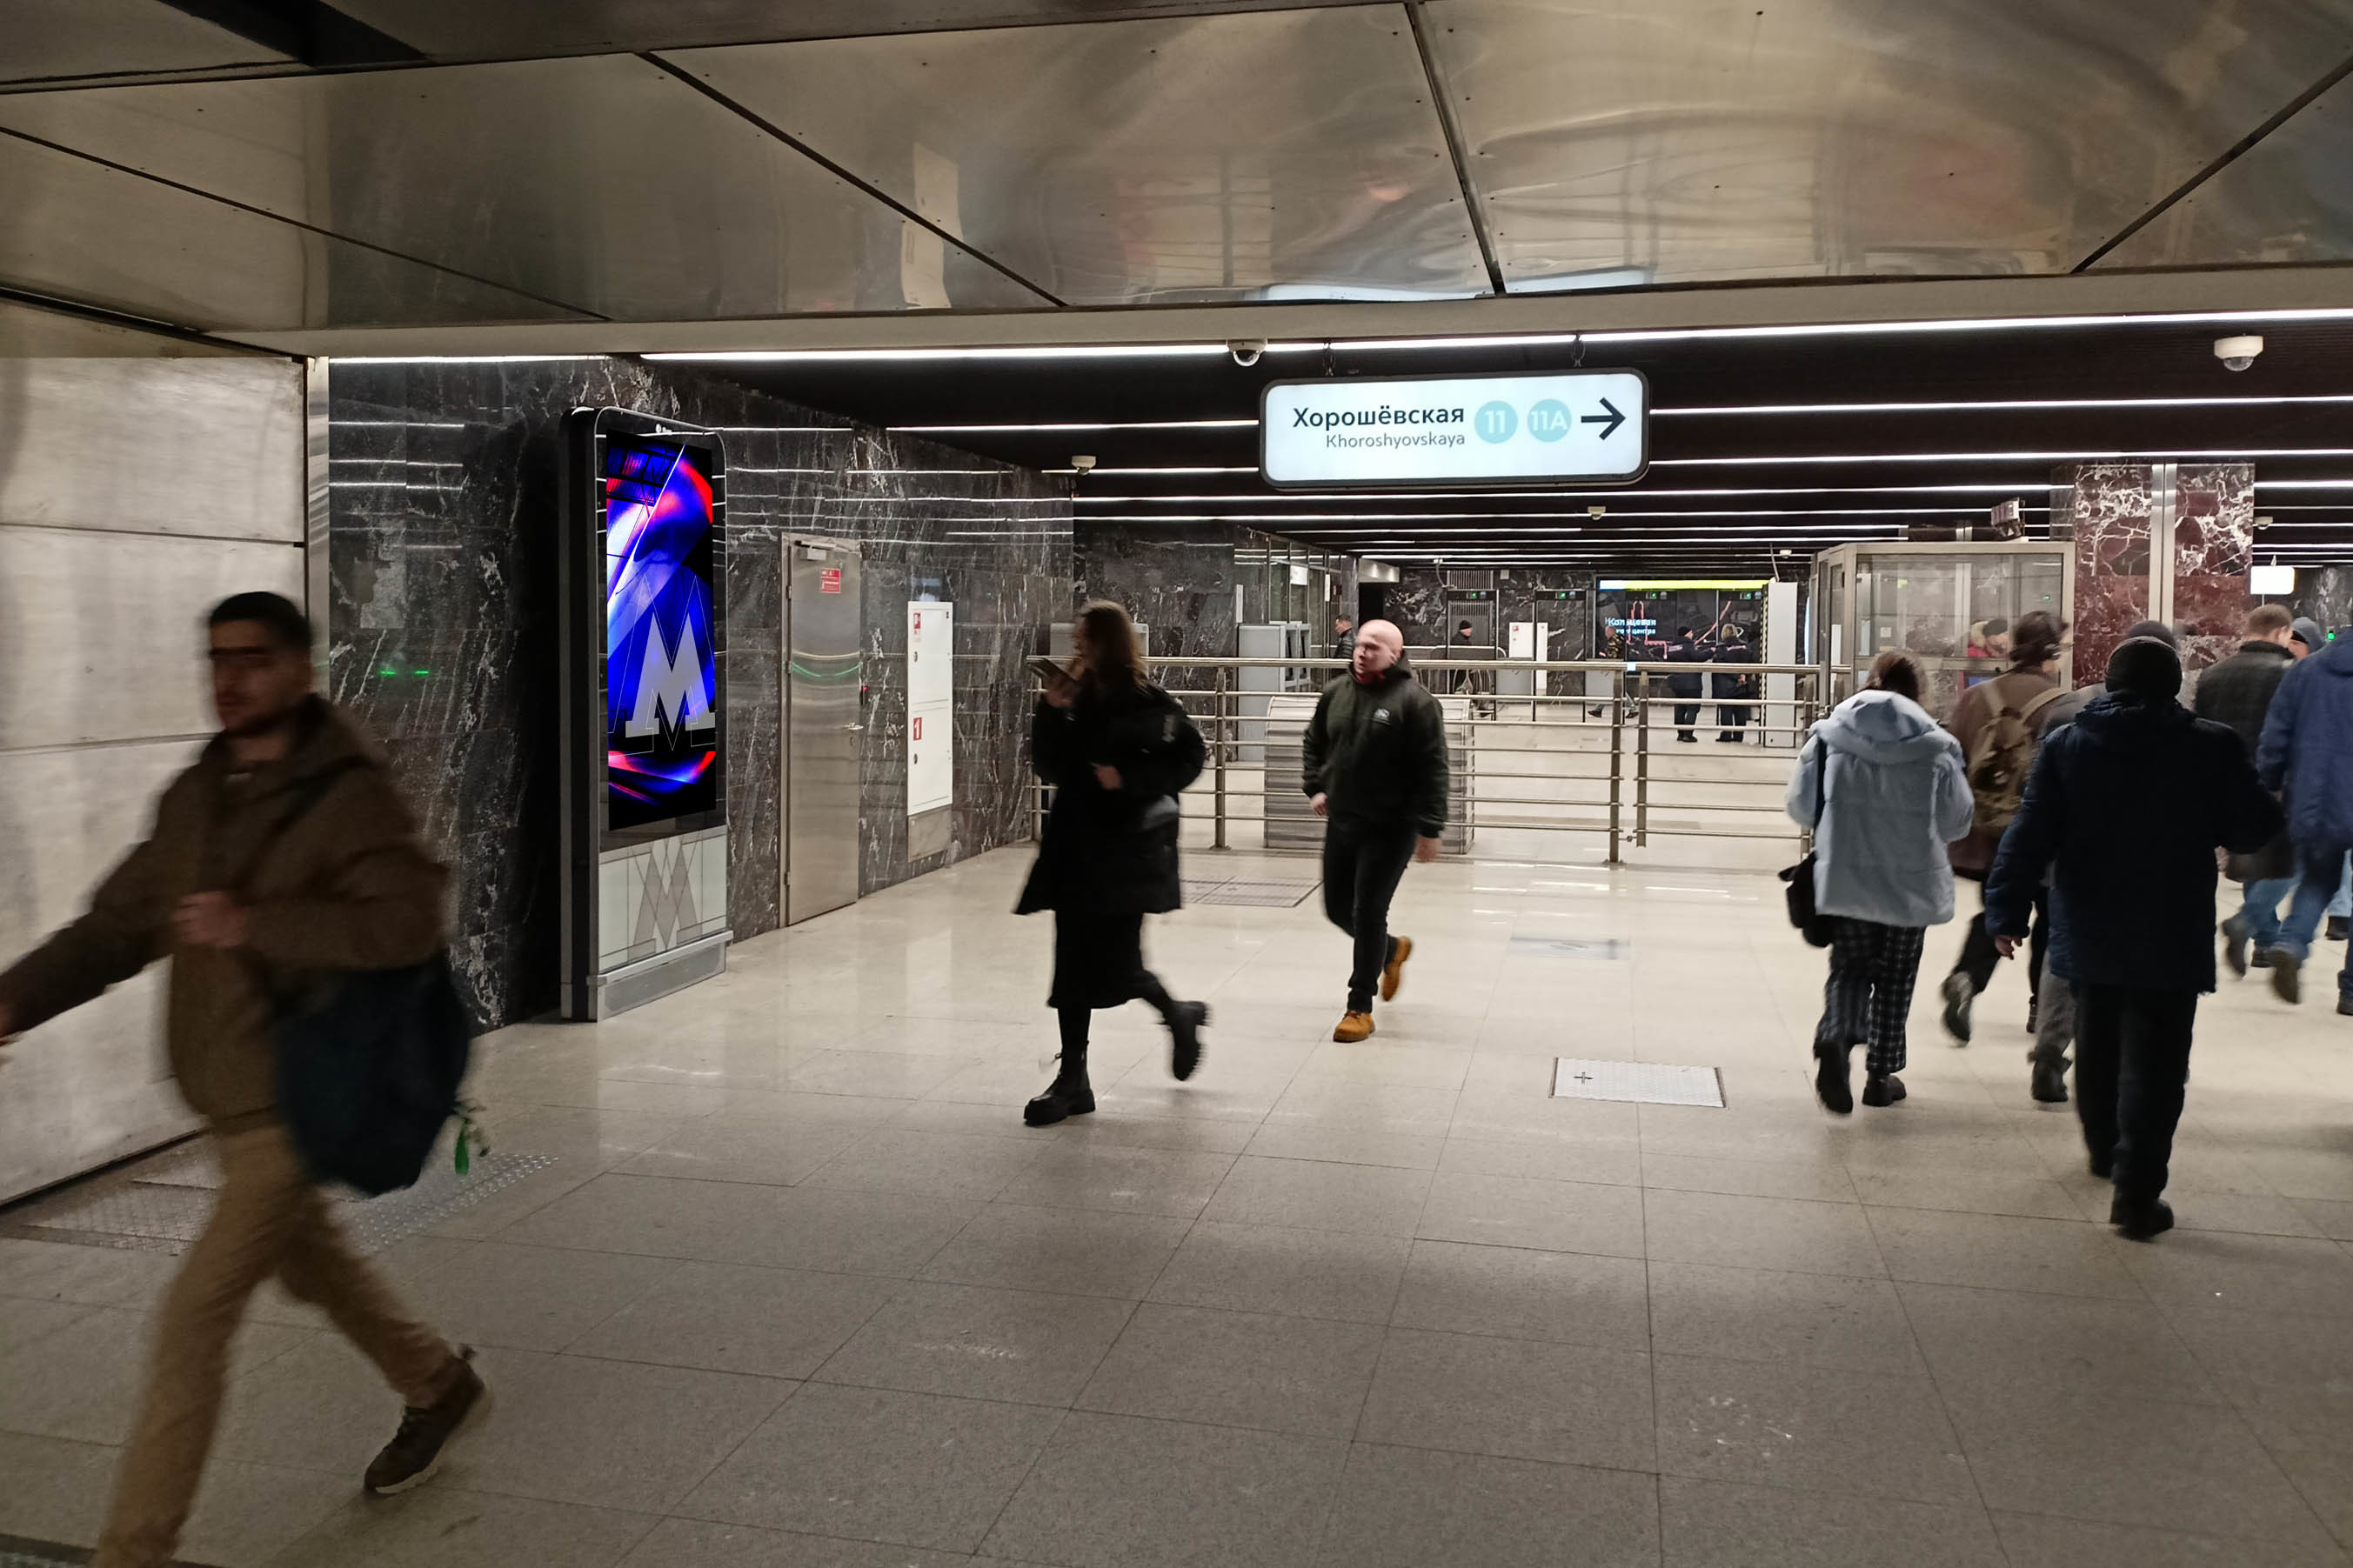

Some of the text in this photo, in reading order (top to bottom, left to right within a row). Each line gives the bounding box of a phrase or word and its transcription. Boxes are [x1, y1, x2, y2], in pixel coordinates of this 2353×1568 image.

[1293, 405, 1464, 431] Хорошёвская
[1485, 410, 1505, 434] 11
[1327, 431, 1465, 450] Khoroshyovskaya
